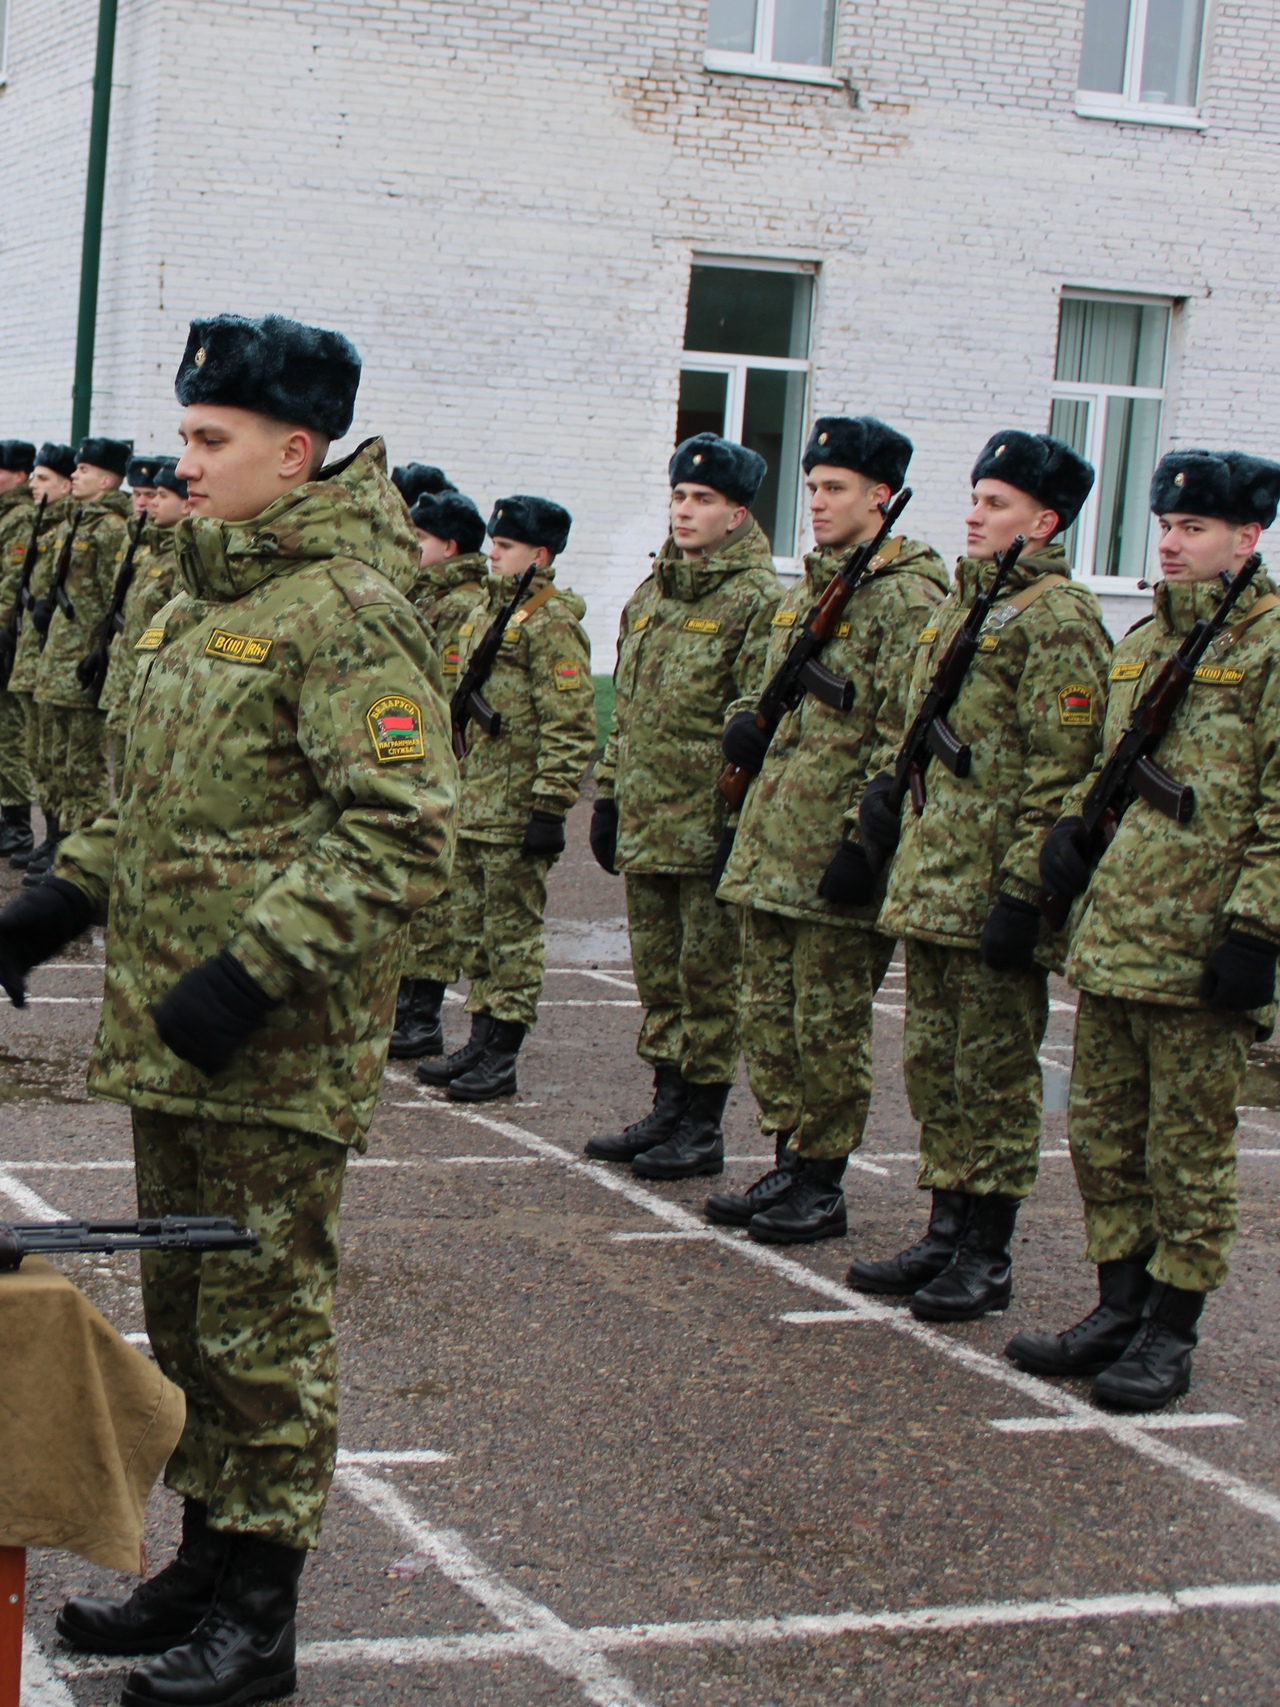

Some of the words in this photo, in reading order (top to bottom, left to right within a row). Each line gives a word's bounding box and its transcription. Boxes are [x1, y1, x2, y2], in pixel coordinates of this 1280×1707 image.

[215, 636, 244, 654] B(III)
[247, 643, 267, 656] Rh+
[371, 700, 415, 719] БЕЛАРУСЬ
